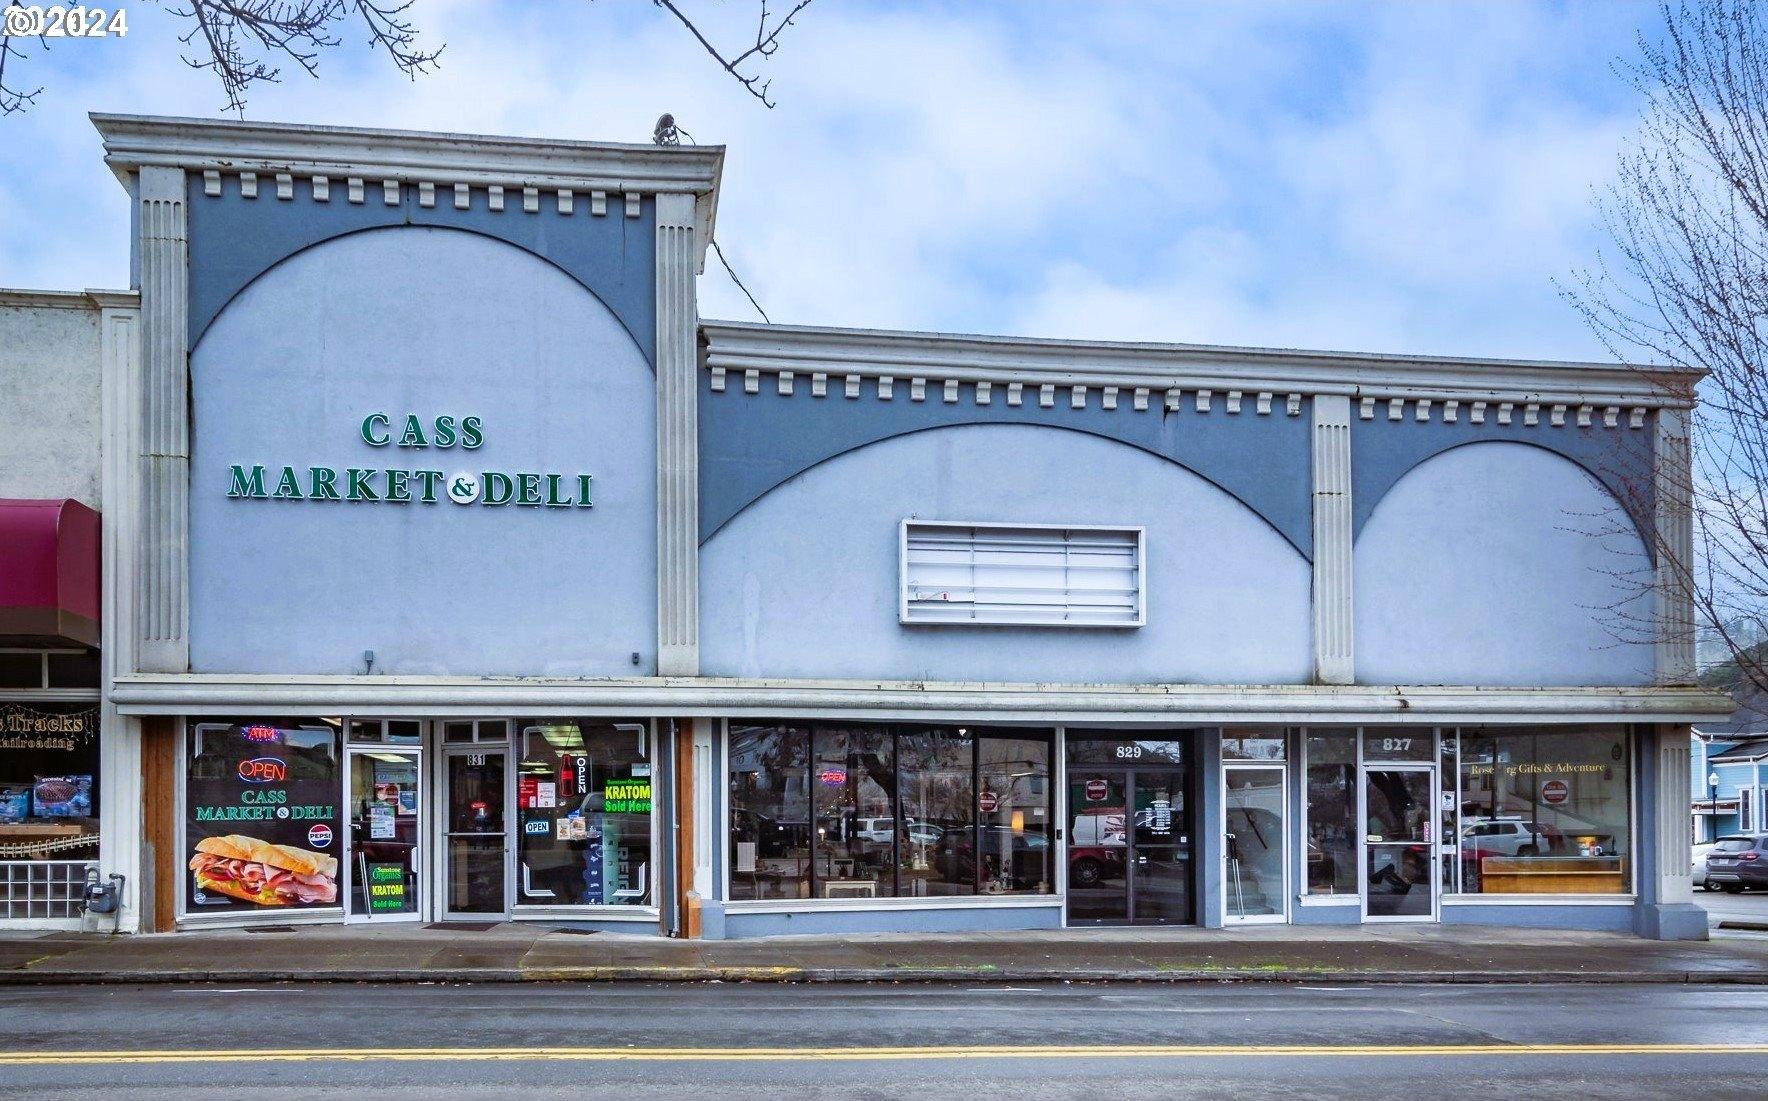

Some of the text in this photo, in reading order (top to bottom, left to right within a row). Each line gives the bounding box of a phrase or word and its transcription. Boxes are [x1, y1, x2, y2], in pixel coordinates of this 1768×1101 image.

[360, 413, 484, 449] CASS
[226, 464, 594, 508] MARKET & DELI
[8, 715, 83, 731] Tracks
[249, 728, 275, 738] ATM
[0, 738, 75, 751] ailroading
[1383, 739, 1412, 750] 827
[1116, 746, 1142, 758] 829
[468, 755, 485, 765] 831
[239, 760, 286, 781] OPEN
[1518, 764, 1542, 774] Gifts
[1543, 764, 1554, 774] &
[576, 757, 586, 794] OPEN
[821, 772, 847, 781] OPEN
[241, 790, 288, 804] CASS
[606, 785, 650, 799] KRATOM
[606, 801, 652, 811] Sold Here
[196, 806, 333, 820] MARKET & DELI
[527, 822, 547, 831] OPEN
[372, 885, 403, 895] KRATOM
